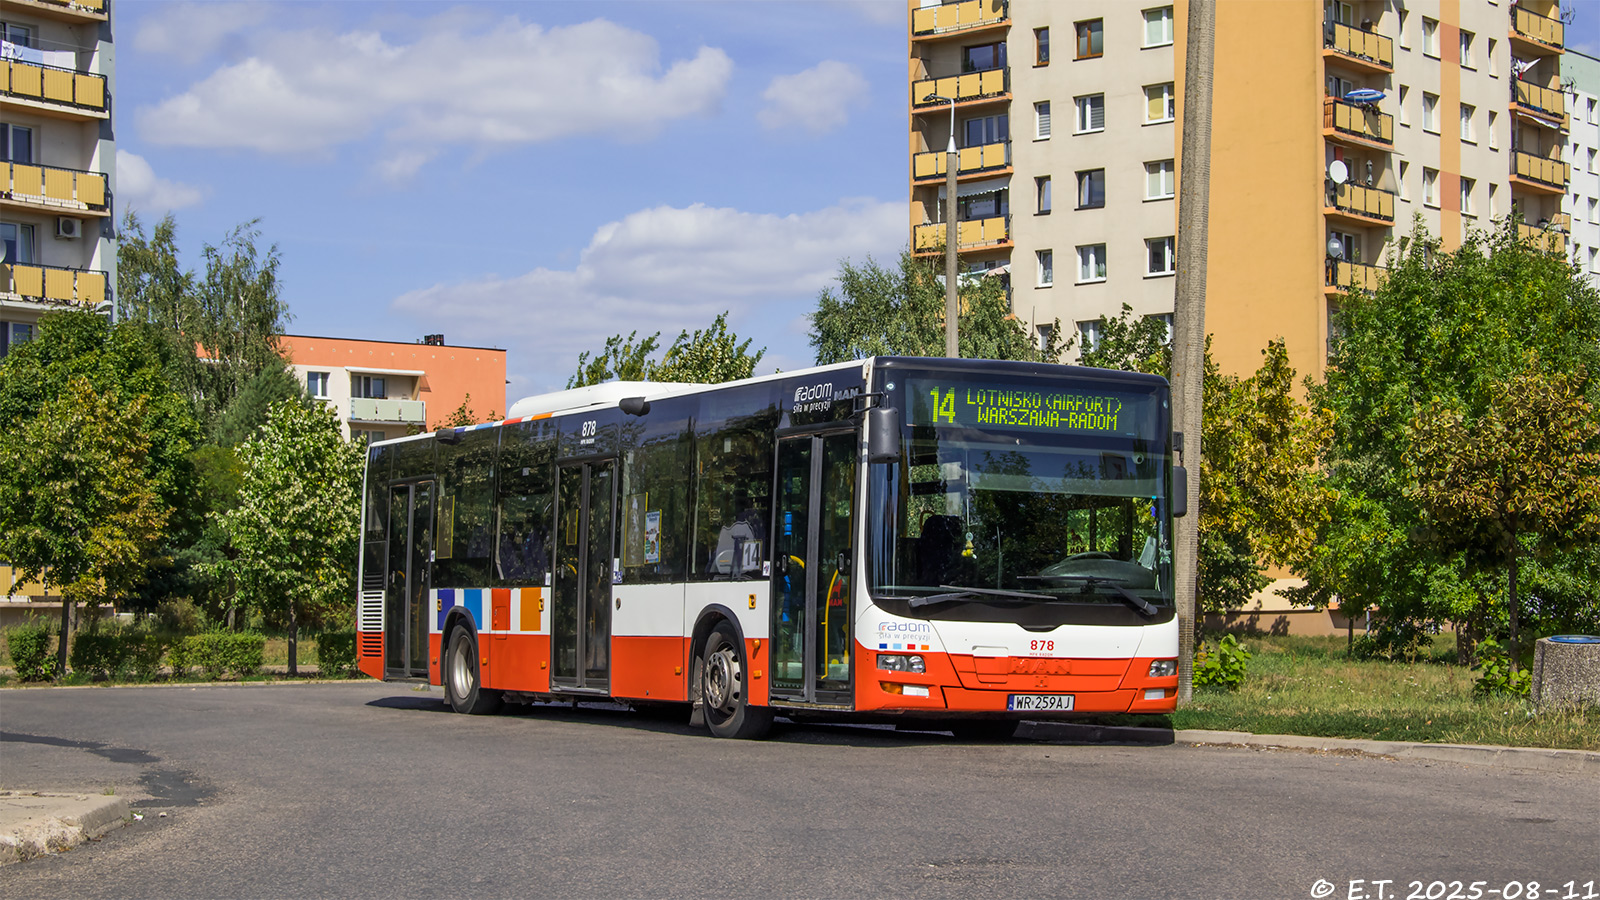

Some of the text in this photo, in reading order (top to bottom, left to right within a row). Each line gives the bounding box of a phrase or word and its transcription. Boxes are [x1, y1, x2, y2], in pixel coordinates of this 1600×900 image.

[833, 387, 859, 401] MAN
[966, 388, 1122, 414] LOTNISKO (AIRPORT)
[930, 385, 956, 424] 14
[977, 406, 1118, 431] WARSZAWA-RADOM
[582, 421, 596, 436] 878
[745, 543, 760, 566] 14
[878, 622, 930, 633] radom
[903, 634, 931, 642] precyzji
[1030, 639, 1055, 651] 878
[1011, 658, 1071, 674] MAN
[1016, 696, 1032, 709] WR
[1035, 696, 1070, 709] 259AJ
